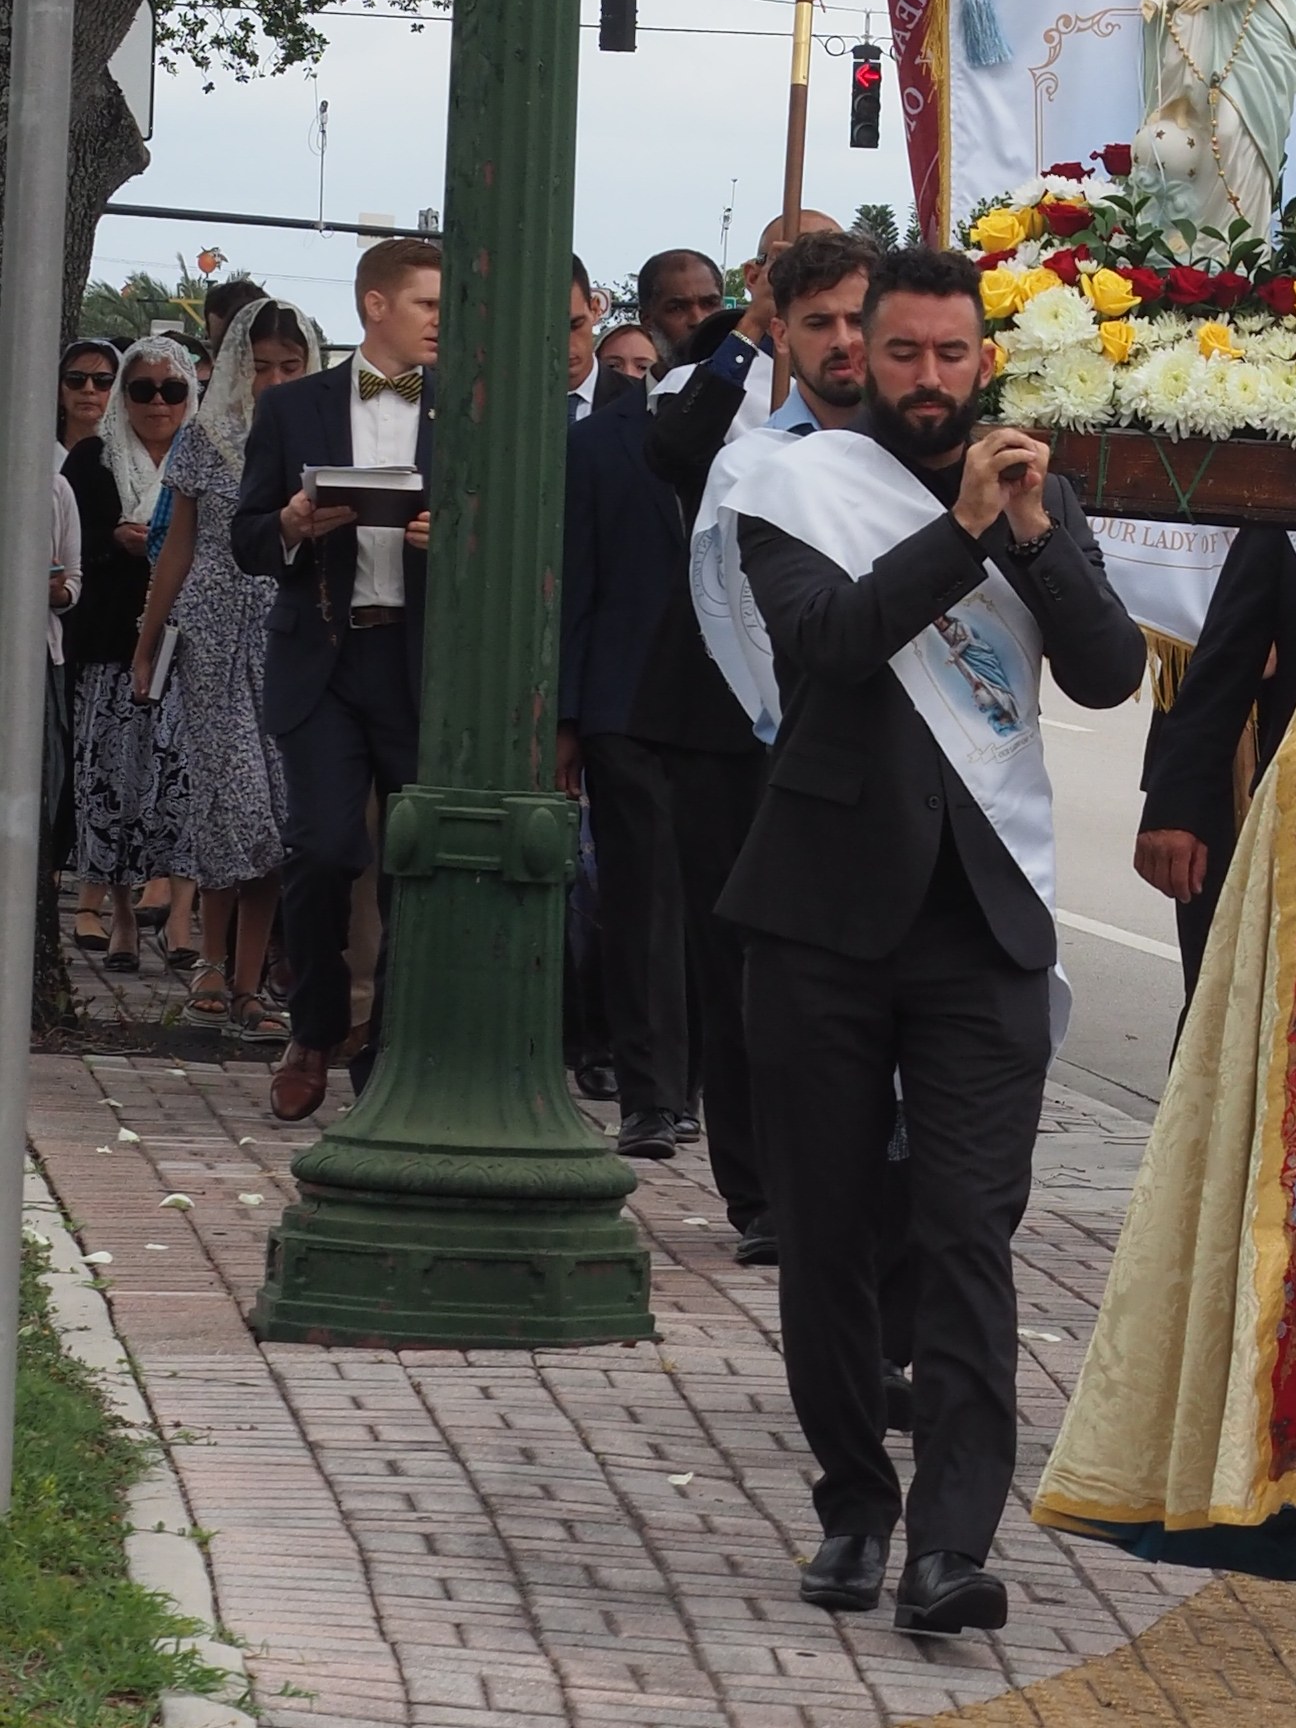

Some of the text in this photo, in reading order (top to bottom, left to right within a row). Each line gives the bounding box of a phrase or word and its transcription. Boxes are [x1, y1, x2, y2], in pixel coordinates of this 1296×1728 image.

[1090, 518, 1137, 544] OUR
[1141, 526, 1199, 553] LADY
[1201, 531, 1219, 554] OF
